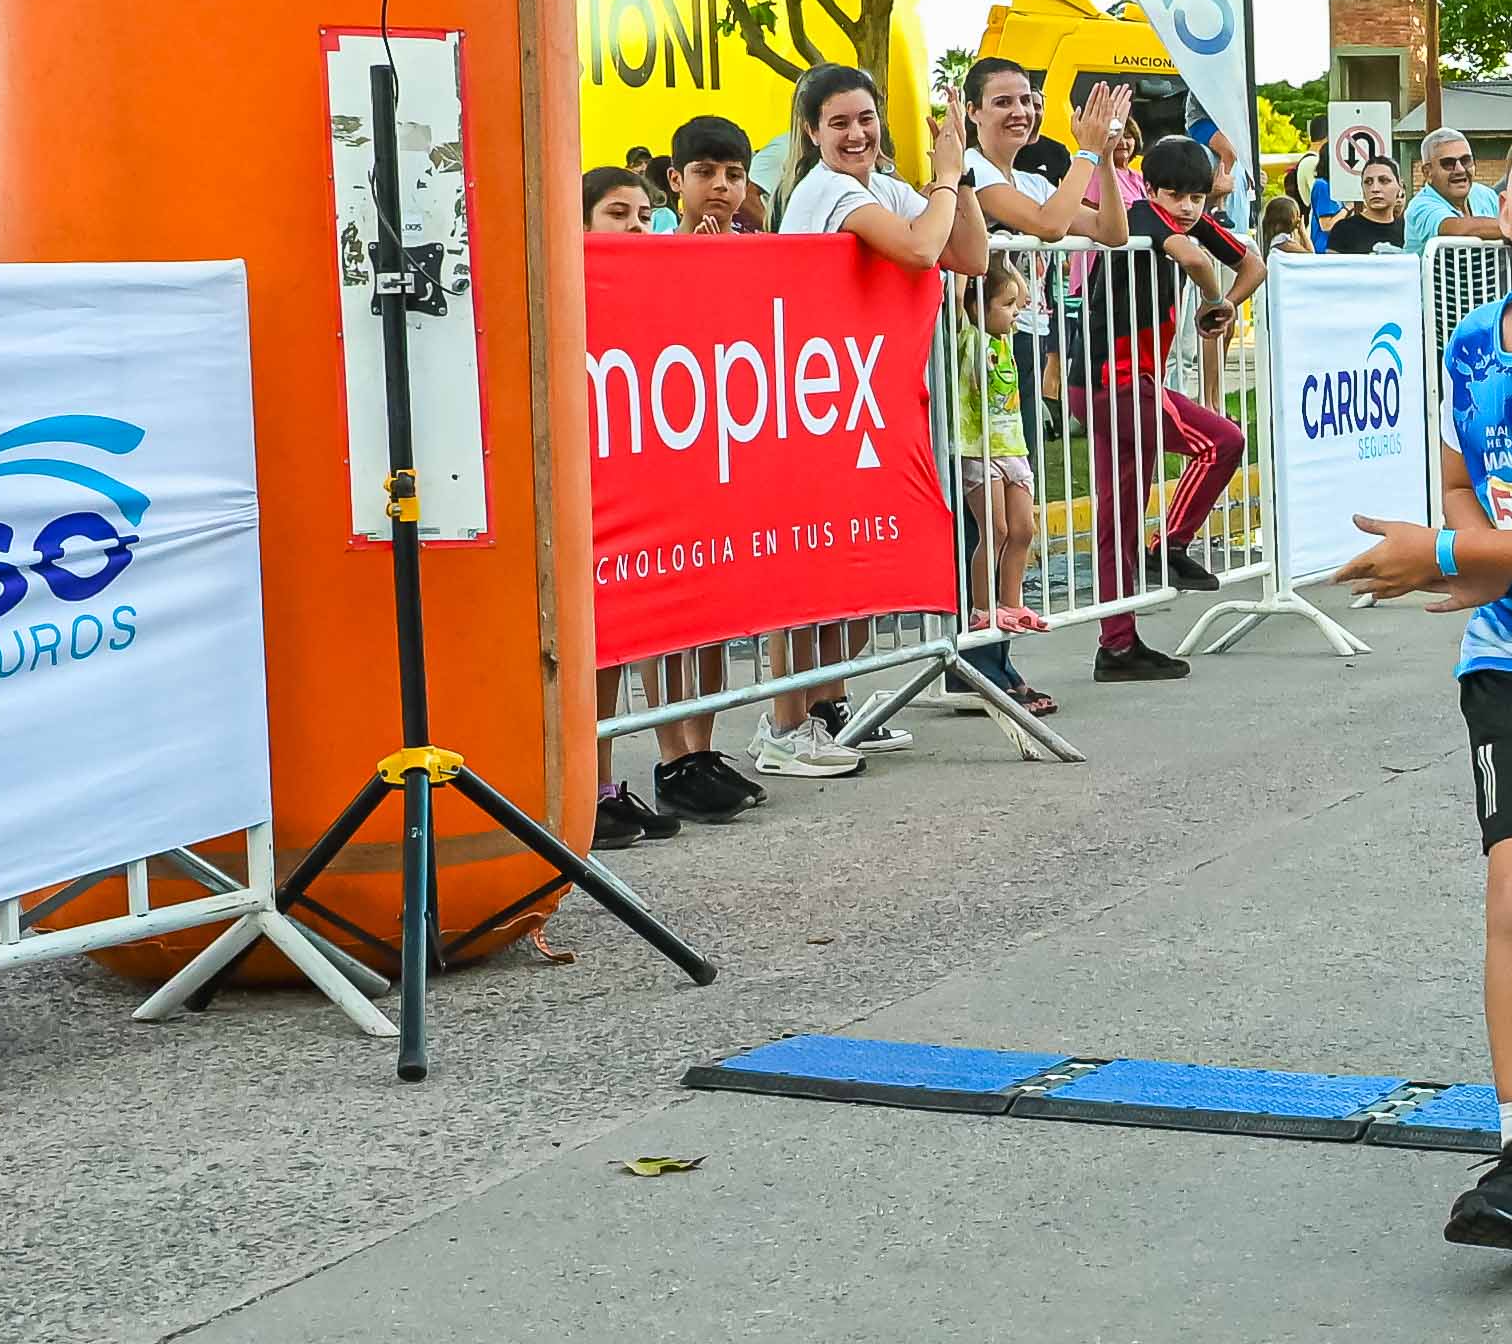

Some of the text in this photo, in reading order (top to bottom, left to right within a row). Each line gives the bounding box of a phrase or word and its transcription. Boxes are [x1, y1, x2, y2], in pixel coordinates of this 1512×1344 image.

[1302, 367, 1400, 439] CARUSO
[1358, 433, 1402, 460] SEGUROS
[753, 529, 777, 557] EN
[792, 522, 834, 551] TUS
[851, 515, 899, 543] PIES
